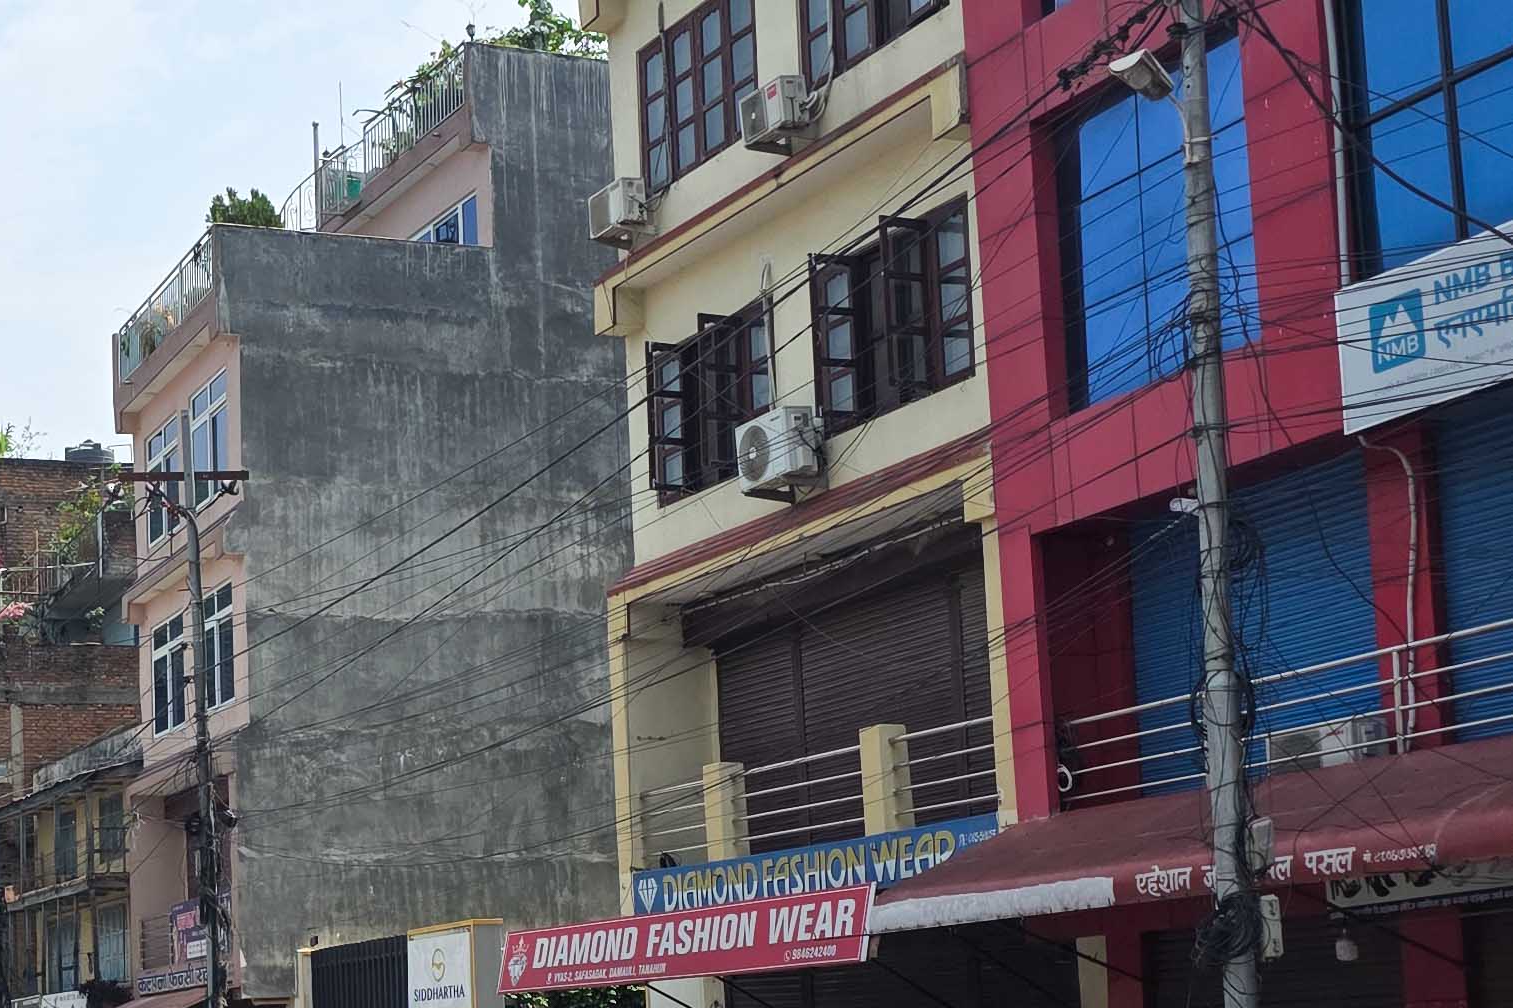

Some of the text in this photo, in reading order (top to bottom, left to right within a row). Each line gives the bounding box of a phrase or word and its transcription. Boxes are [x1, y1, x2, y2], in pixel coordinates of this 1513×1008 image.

[1433, 261, 1490, 305] NMB
[1377, 334, 1419, 365] NMB
[1303, 846, 1357, 876] पसल
[662, 862, 758, 912] DIAMOND
[763, 848, 866, 898] FASHION
[532, 898, 857, 969] DIAMOND FASHION WEAR
[414, 984, 465, 1001] SIDDHARTHA
